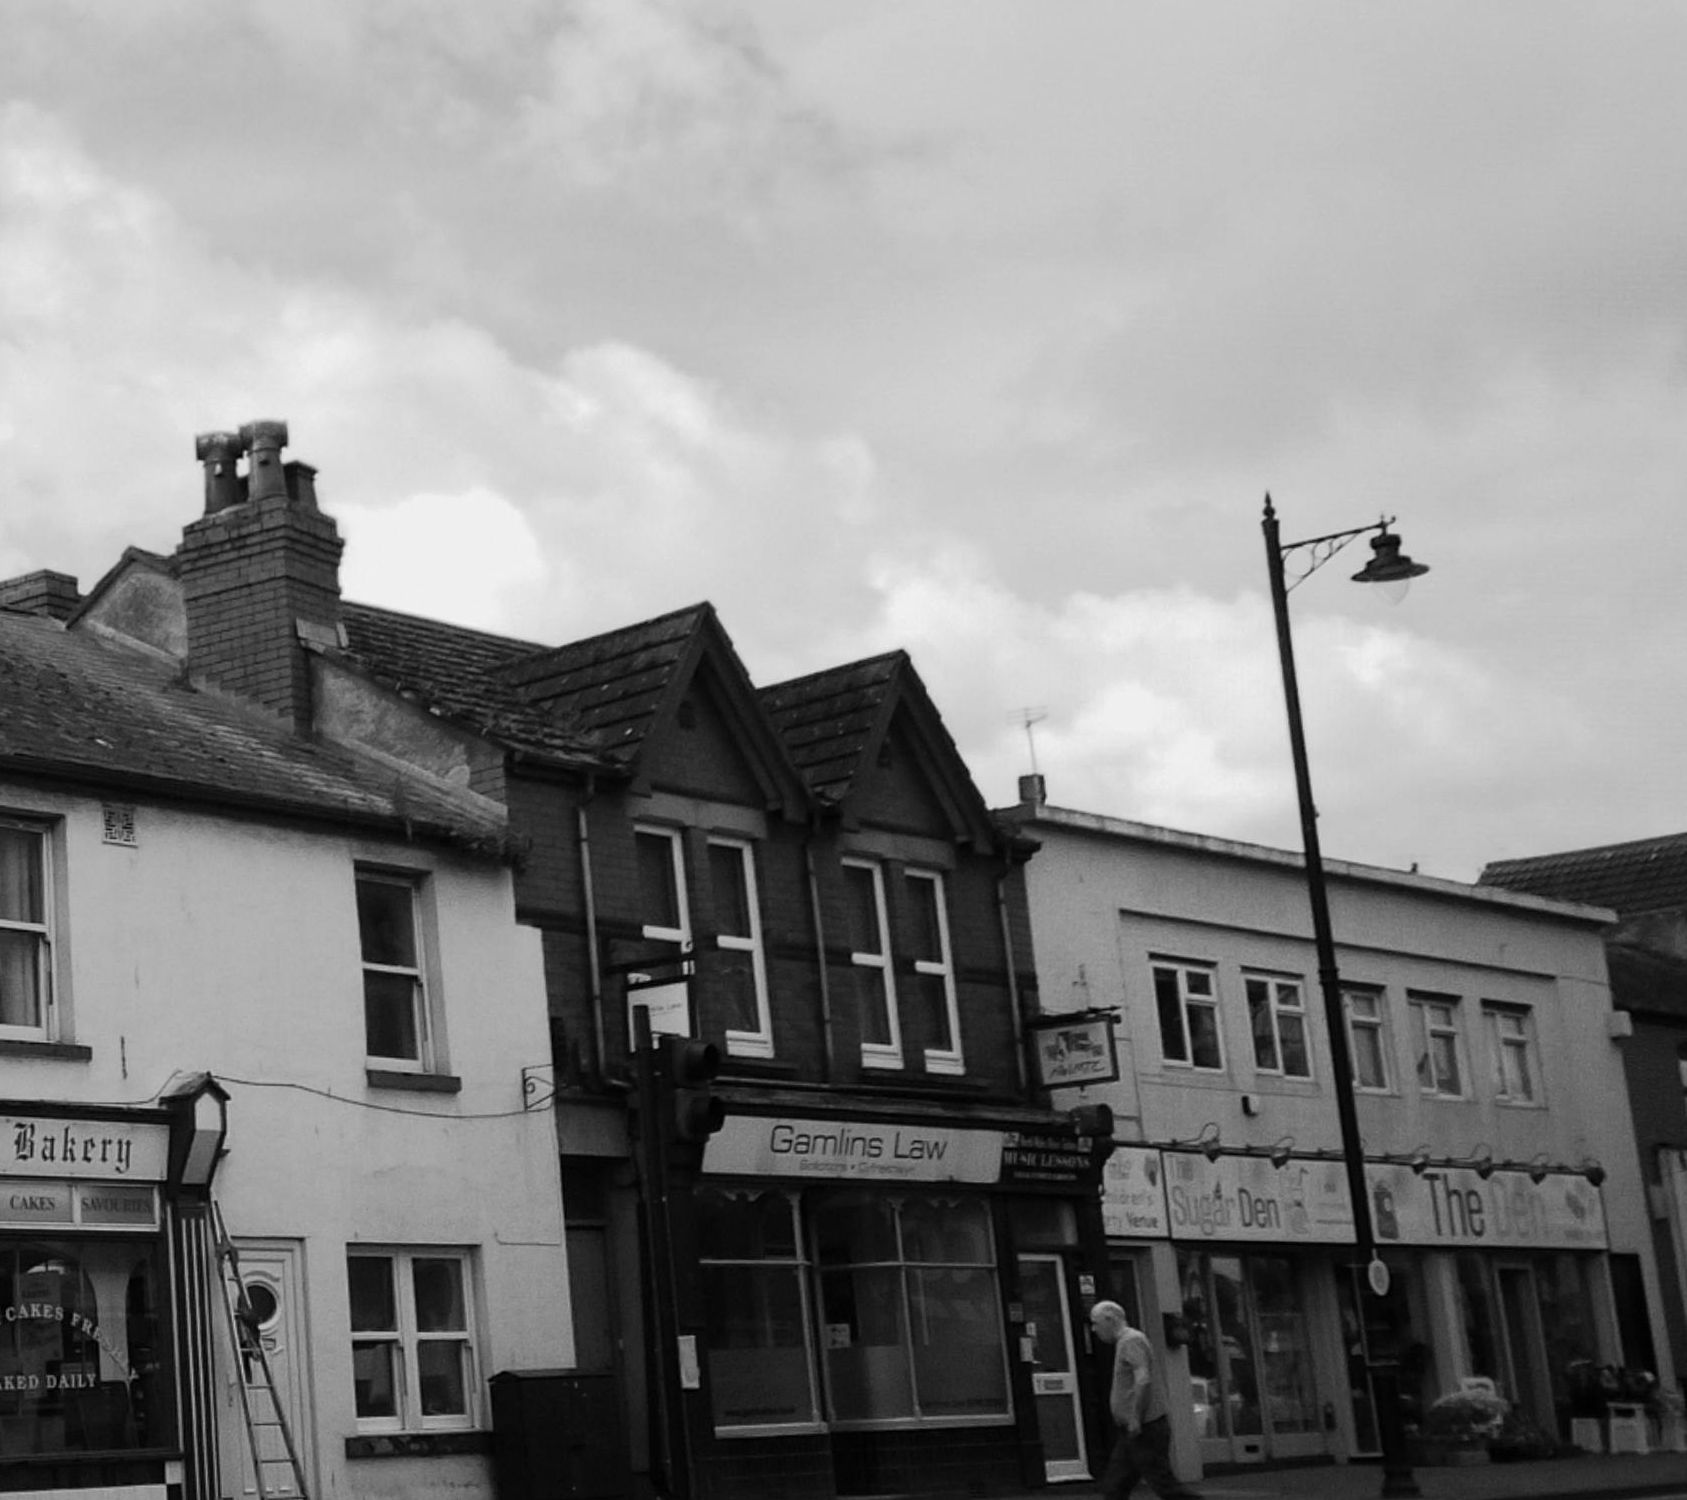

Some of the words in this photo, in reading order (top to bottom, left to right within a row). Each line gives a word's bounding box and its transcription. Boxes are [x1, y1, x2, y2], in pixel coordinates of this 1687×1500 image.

[14, 1122, 133, 1173] Bakery
[769, 1124, 883, 1158] Gamlins
[894, 1131, 947, 1161] Law
[1041, 1153, 1091, 1169] LESSONS
[10, 1194, 56, 1211] CAKES
[81, 1198, 152, 1214] SAVOURIES
[1172, 1185, 1235, 1236] Sugar
[1237, 1188, 1281, 1229] Den
[1422, 1173, 1486, 1237] The
[5, 1303, 65, 1321] CAKES
[46, 1372, 97, 1389] DAILY
